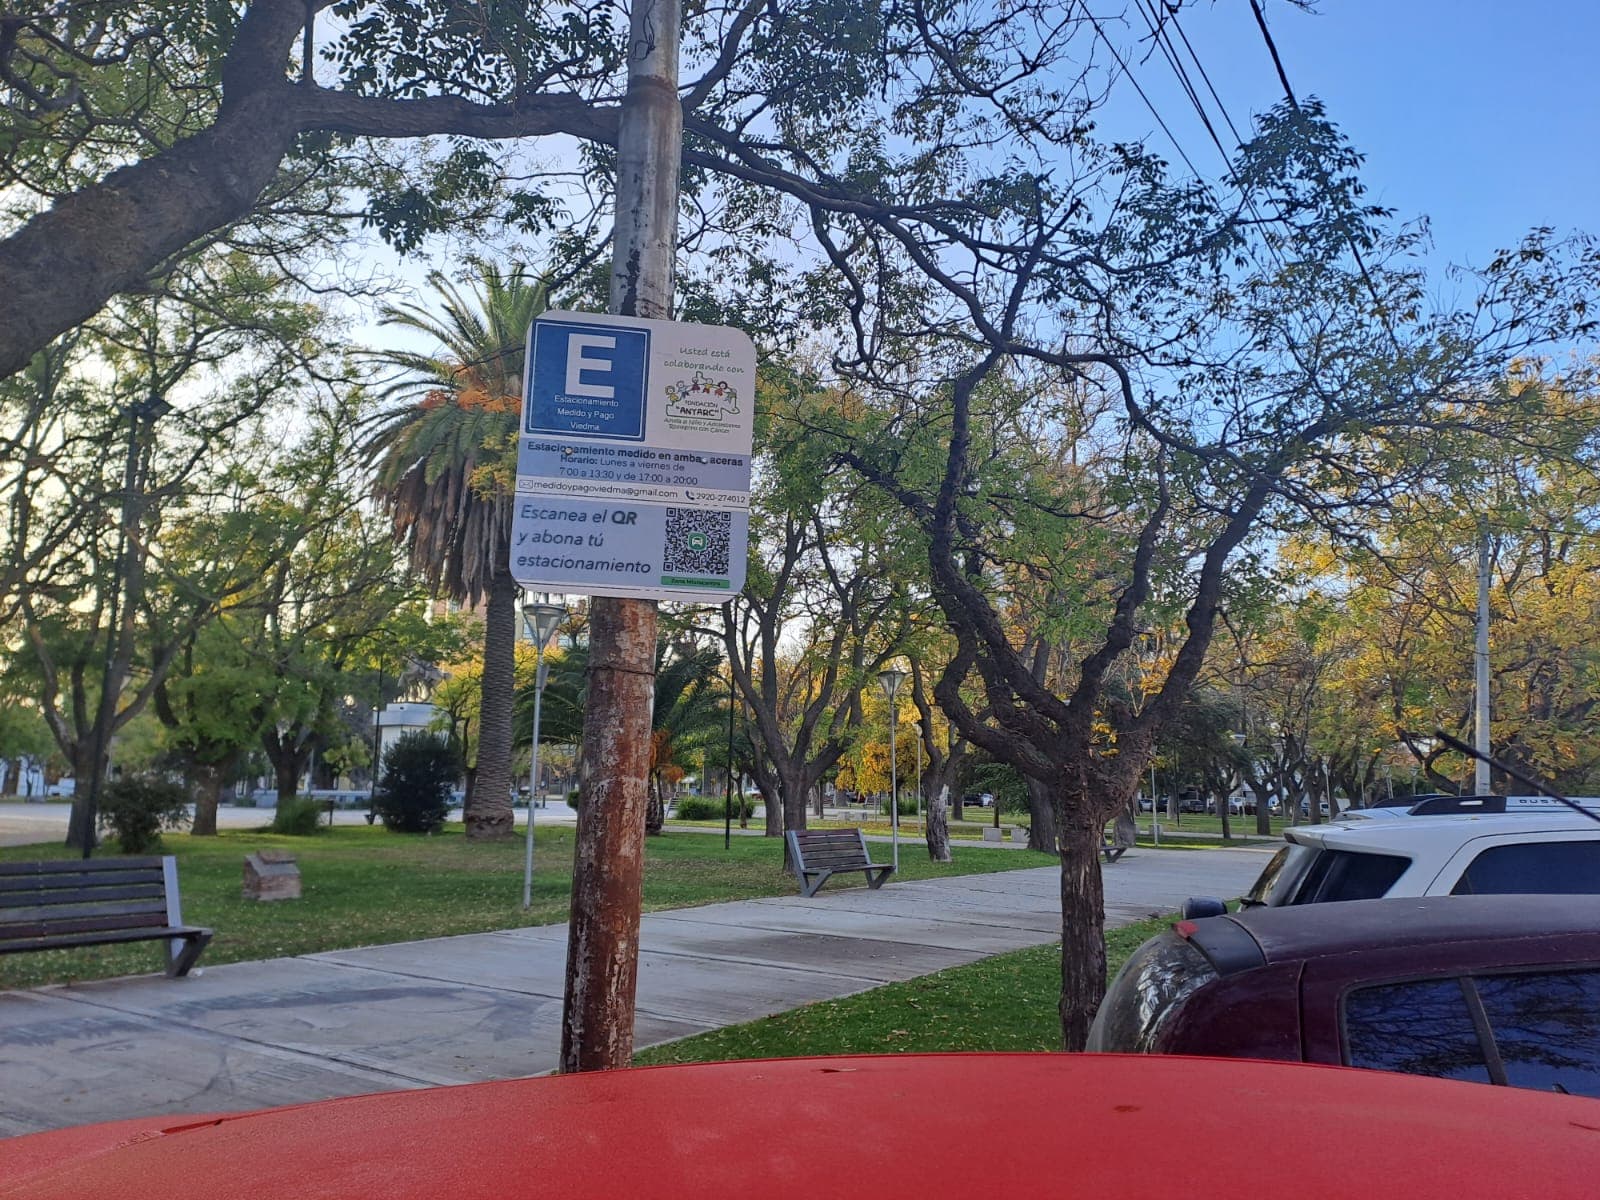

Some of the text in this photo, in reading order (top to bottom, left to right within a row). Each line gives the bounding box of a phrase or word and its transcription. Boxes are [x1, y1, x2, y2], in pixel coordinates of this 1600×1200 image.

[565, 333, 616, 398] E
[554, 395, 619, 407] Estacionamiento
[557, 408, 615, 421] Medido y Pago
[570, 421, 600, 431] Viedma
[527, 441, 615, 456] Estacioamiento
[617, 448, 656, 460] medido
[673, 453, 709, 464] amba
[710, 457, 744, 466] aceras
[560, 454, 598, 465] Horario:
[600, 458, 627, 467] Lunes
[638, 460, 671, 470] viernes
[673, 462, 685, 471] de
[616, 473, 622, 481] y
[623, 472, 636, 481] de
[533, 480, 678, 498] medidoypagoviedma@gmail.com
[521, 504, 637, 525] Escanea el QR
[516, 529, 604, 547] y abona tú
[516, 554, 651, 574] estacionamiento
